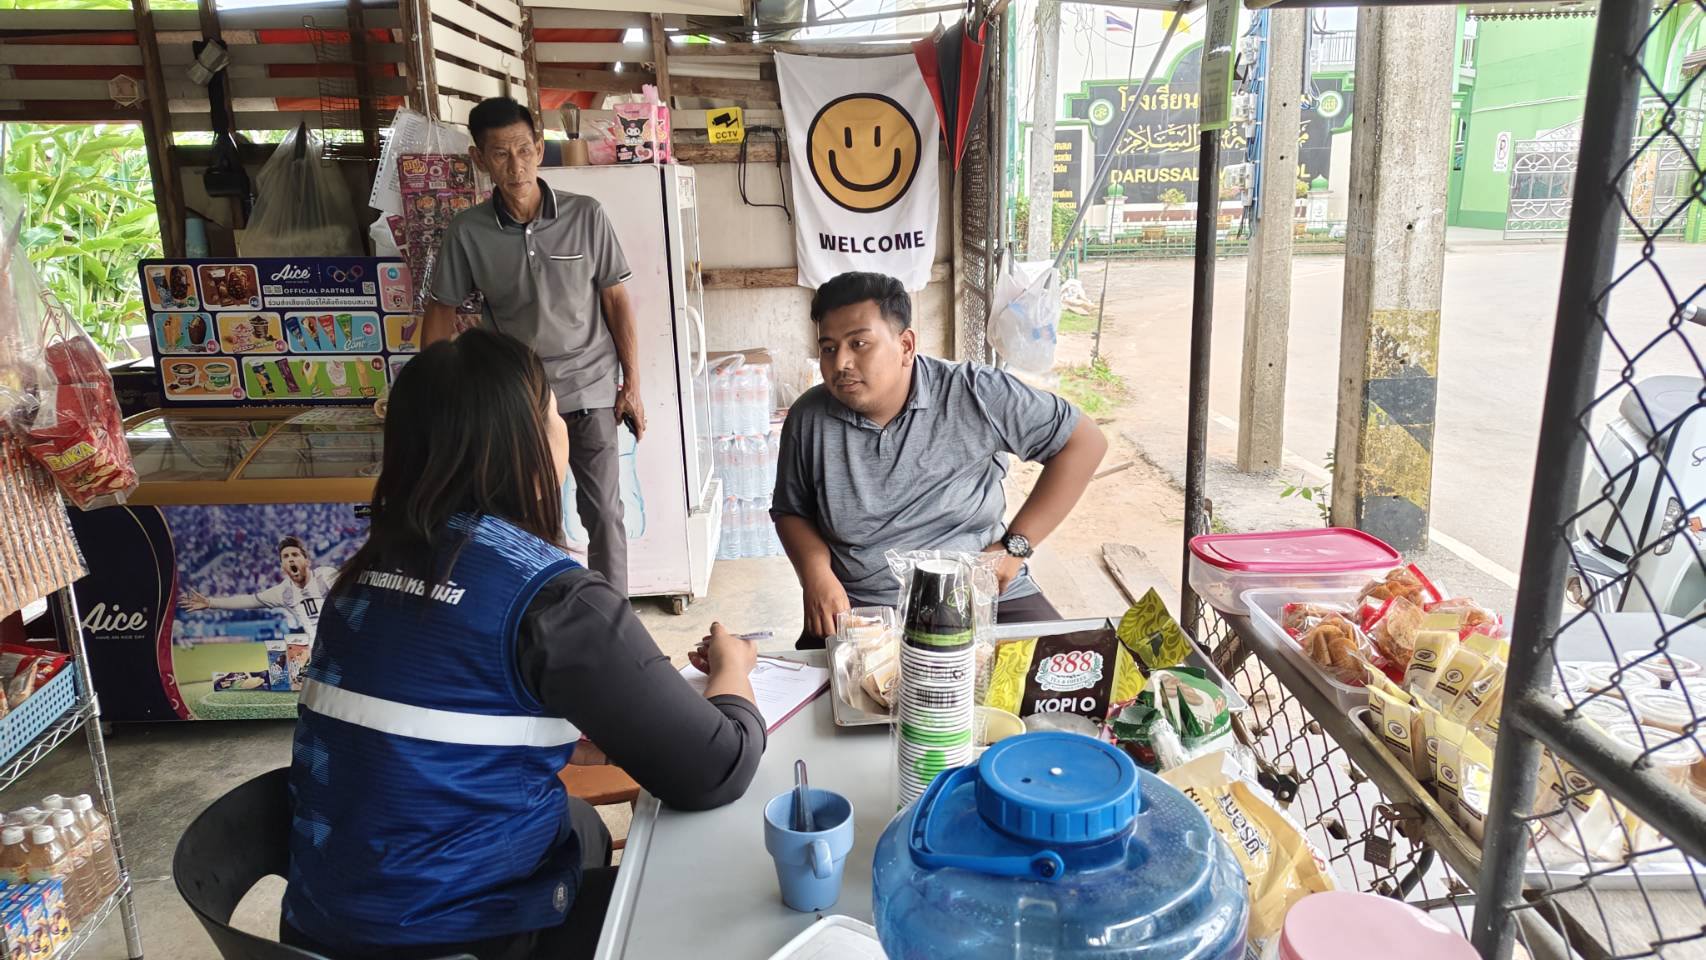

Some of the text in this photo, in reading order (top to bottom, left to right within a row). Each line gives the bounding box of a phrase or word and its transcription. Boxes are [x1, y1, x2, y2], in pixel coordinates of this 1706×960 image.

[715, 130, 738, 139] CCTV
[819, 231, 925, 254] WELCOME
[271, 264, 311, 280] Aice
[300, 598, 318, 616] 10
[80, 602, 148, 634] Aice
[1050, 652, 1093, 673] 888
[1034, 696, 1096, 713] KOPI O
